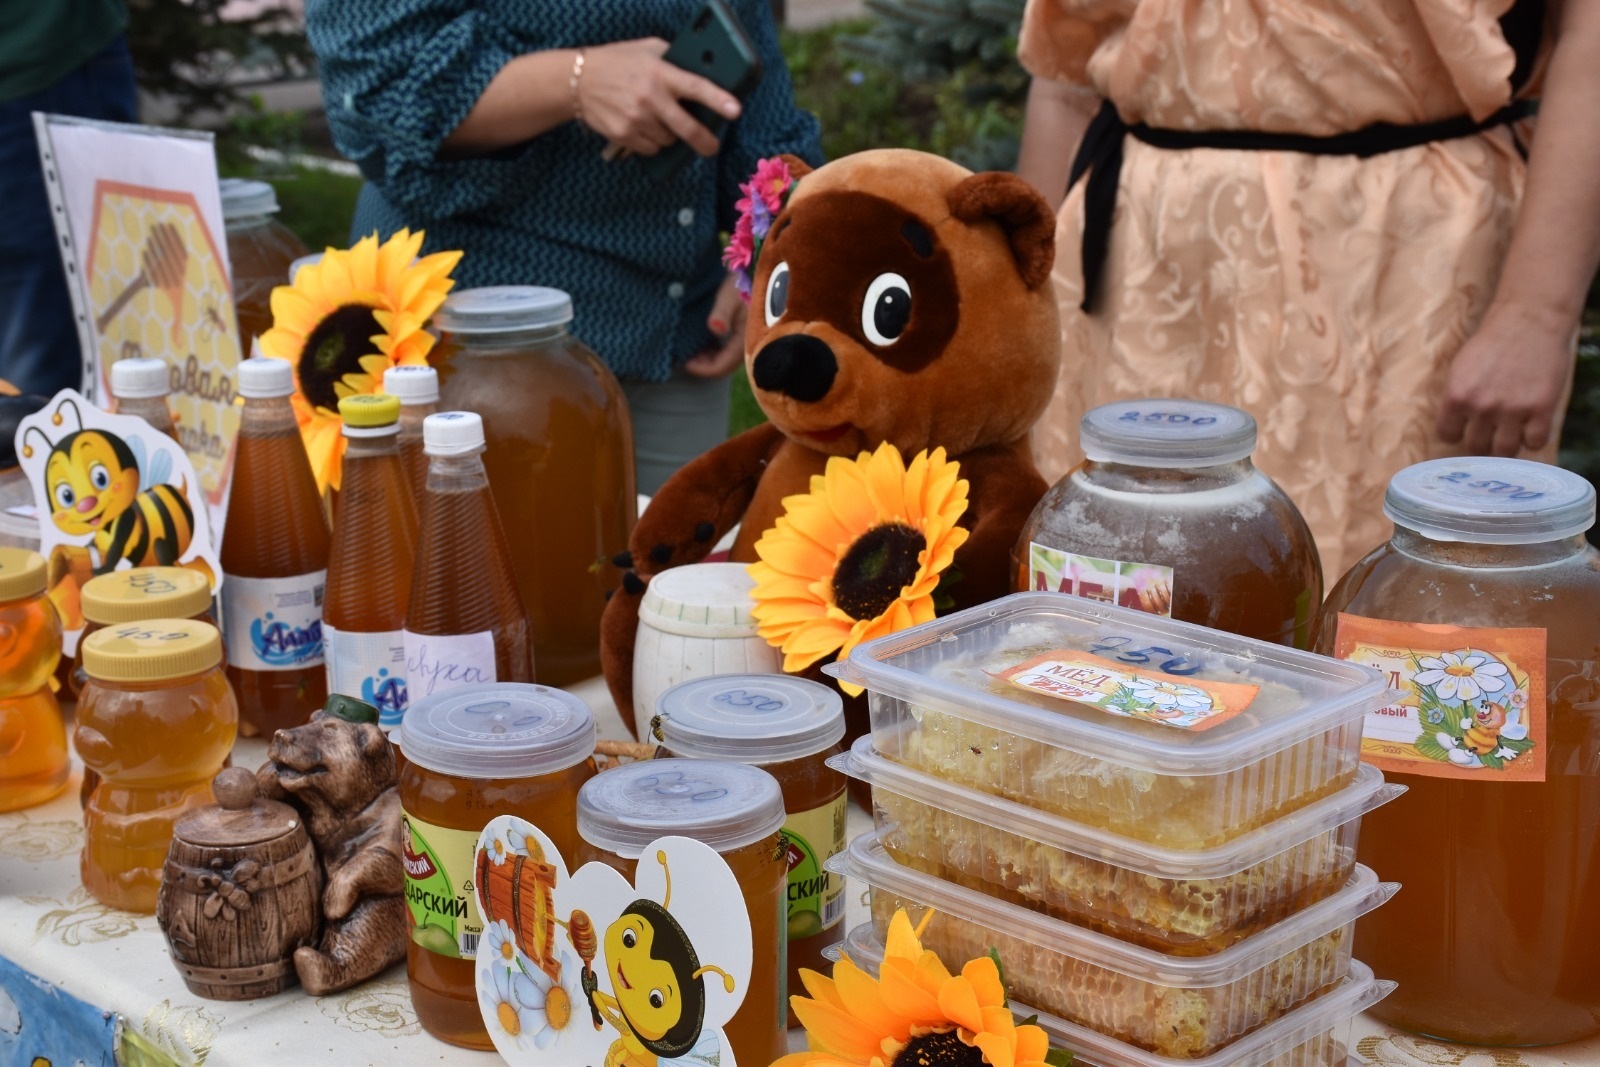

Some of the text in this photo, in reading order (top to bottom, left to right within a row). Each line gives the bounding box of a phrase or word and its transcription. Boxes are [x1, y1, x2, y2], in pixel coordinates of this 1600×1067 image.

[1118, 411, 1217, 425] 2500
[1438, 471, 1545, 500] 2500
[116, 627, 189, 641] 450
[1045, 664, 1112, 689] МЁД
[714, 689, 784, 711] 650
[404, 877, 468, 919] ДАРСКИЙ
[787, 869, 830, 902] СКИЙ
